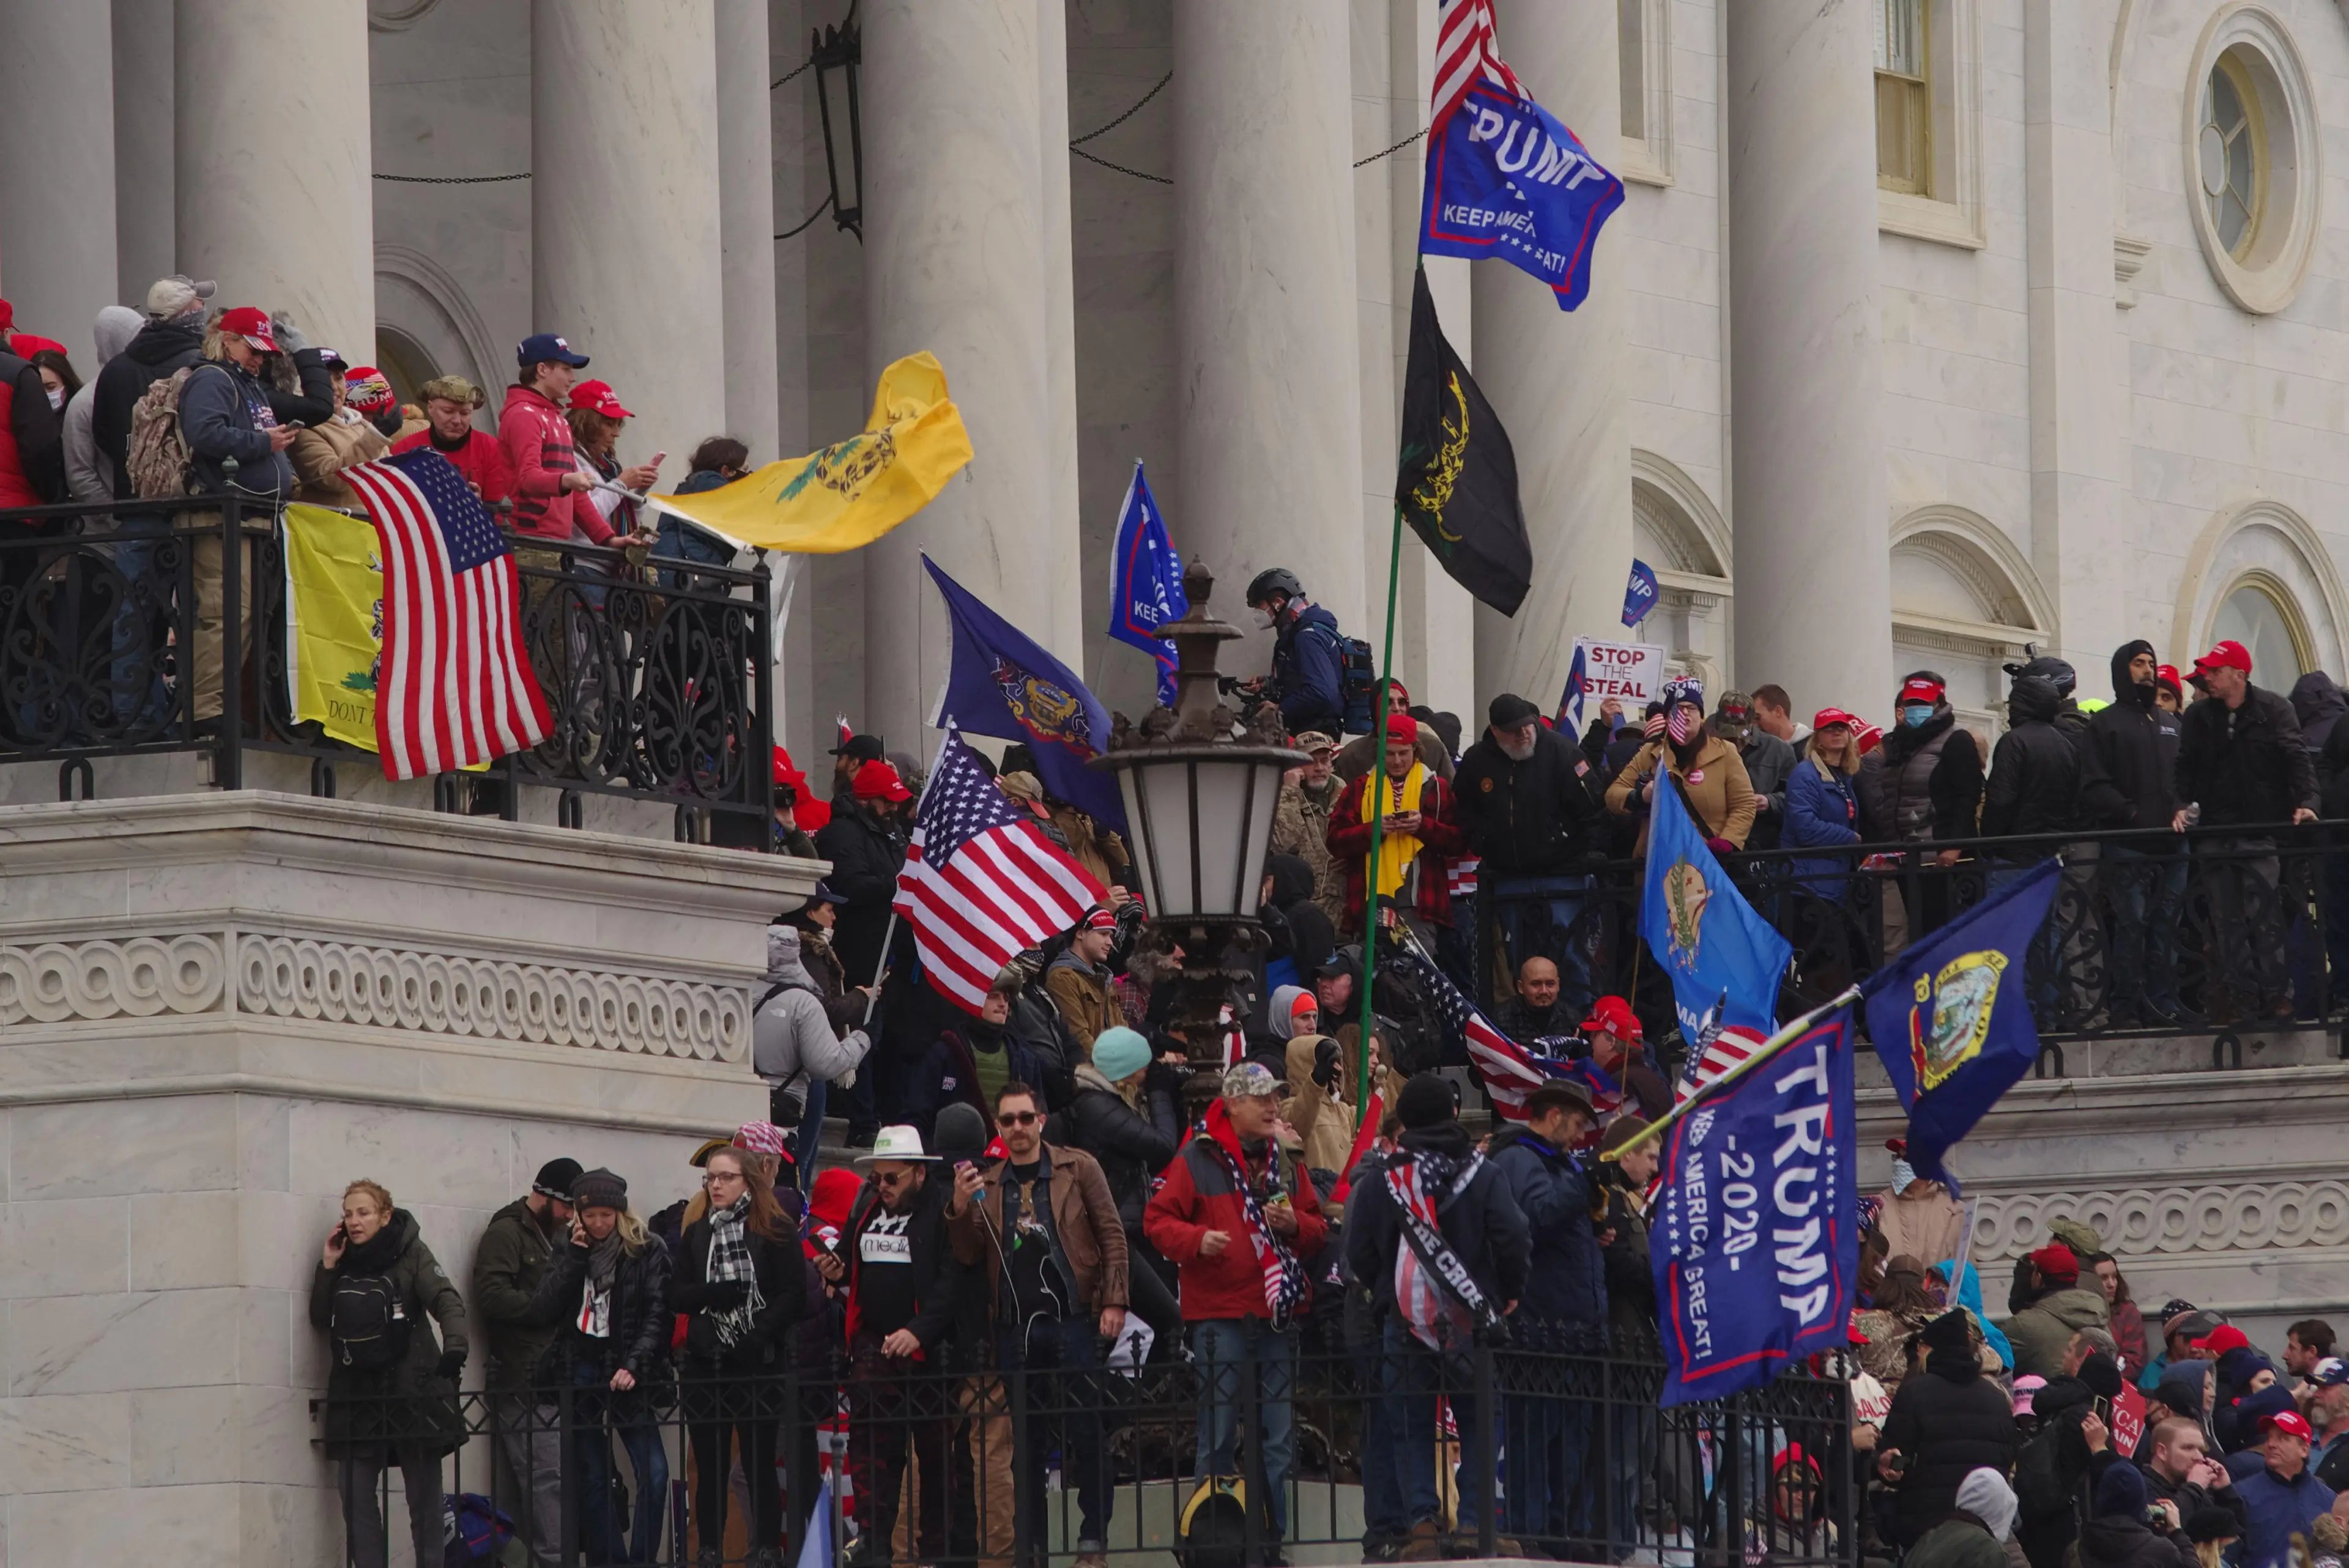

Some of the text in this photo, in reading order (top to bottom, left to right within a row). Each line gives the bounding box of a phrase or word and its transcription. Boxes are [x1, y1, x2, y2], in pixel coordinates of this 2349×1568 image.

[1444, 204, 1494, 227] KEEP
[1134, 600, 1159, 624] KEE
[1591, 646, 1646, 665] STOP
[1601, 664, 1633, 680] THE
[1584, 678, 1647, 698] STEAL
[328, 700, 369, 725] DONT
[1774, 1044, 1830, 1327] TRUMP
[1684, 1108, 1716, 1360] KEEP AMERICA GREAT!
[1434, 1250, 1484, 1311] CROS
